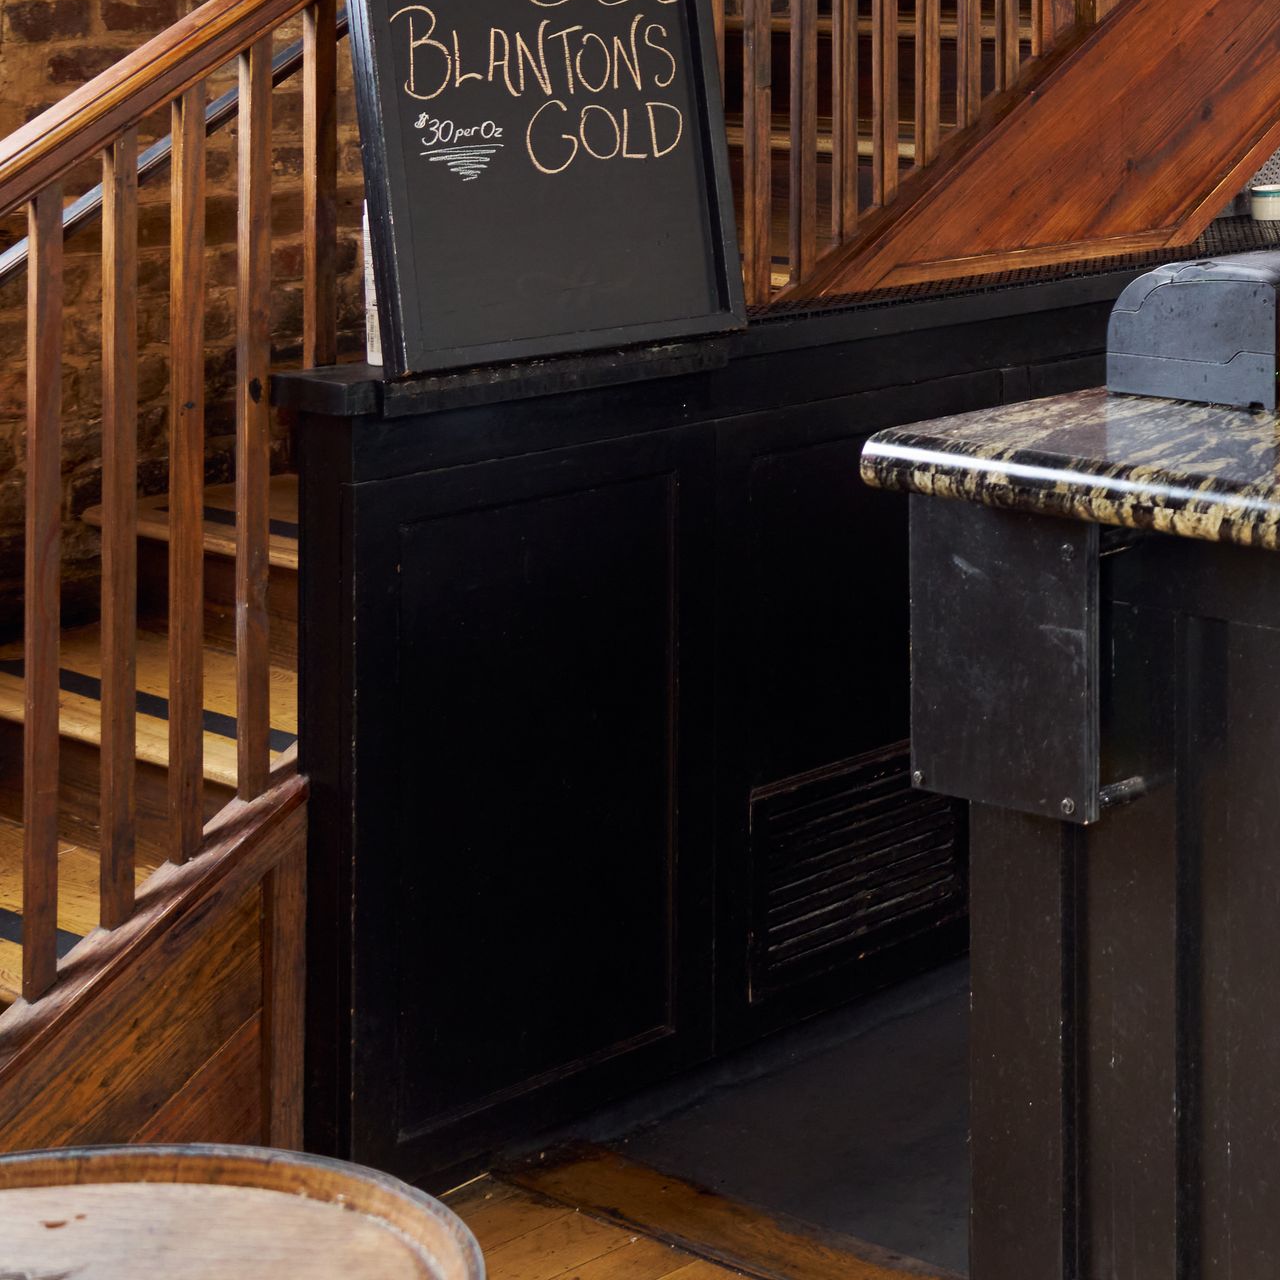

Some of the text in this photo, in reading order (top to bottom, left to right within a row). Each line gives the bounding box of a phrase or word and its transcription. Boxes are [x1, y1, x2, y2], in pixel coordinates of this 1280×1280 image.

[389, 5, 677, 100] BLANTONS
[454, 126, 480, 143] per
[526, 100, 683, 174] GOLD
